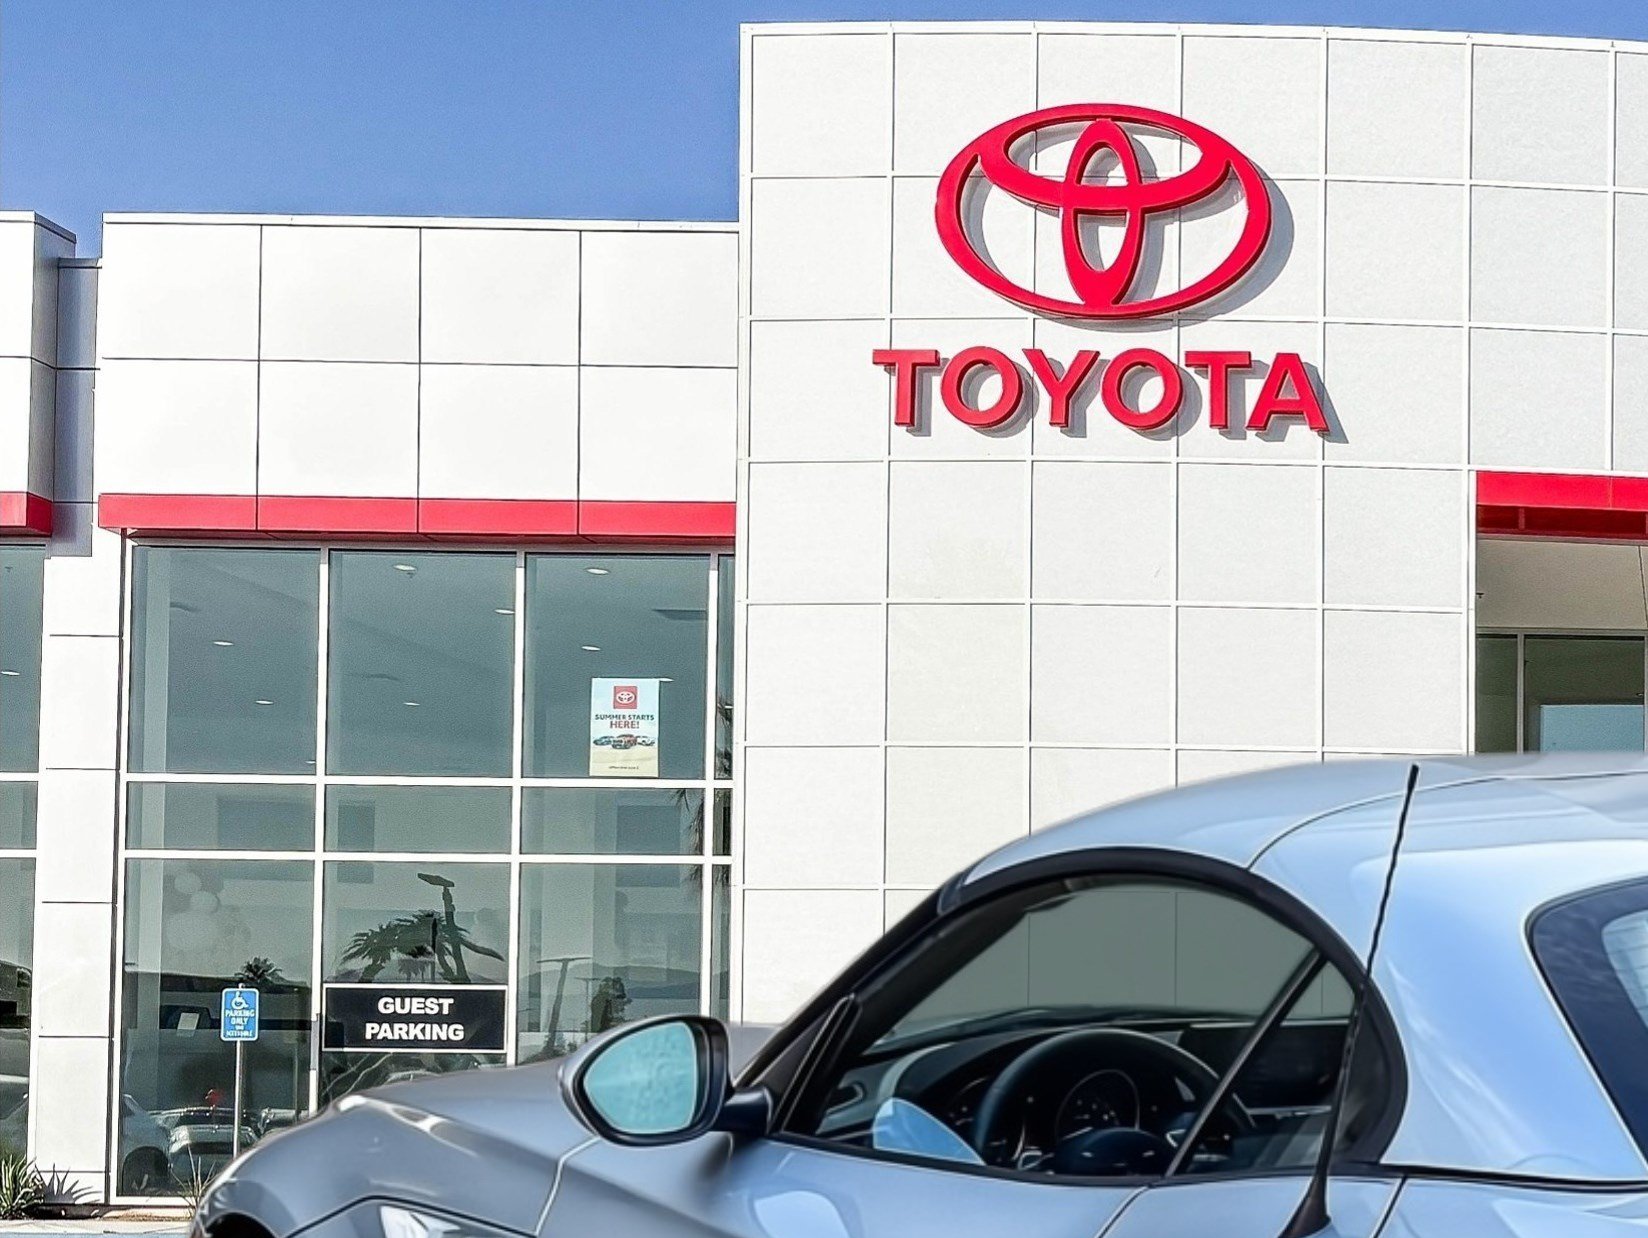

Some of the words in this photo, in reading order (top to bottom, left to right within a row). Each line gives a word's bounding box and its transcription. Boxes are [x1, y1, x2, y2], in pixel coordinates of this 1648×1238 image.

[872, 345, 1330, 434] TOYOTA
[610, 721, 640, 729] HERE!
[377, 997, 454, 1015] GUEST
[225, 1009, 255, 1018] PARKING
[230, 1017, 249, 1025] ONLY
[365, 1022, 464, 1041] PARKING
